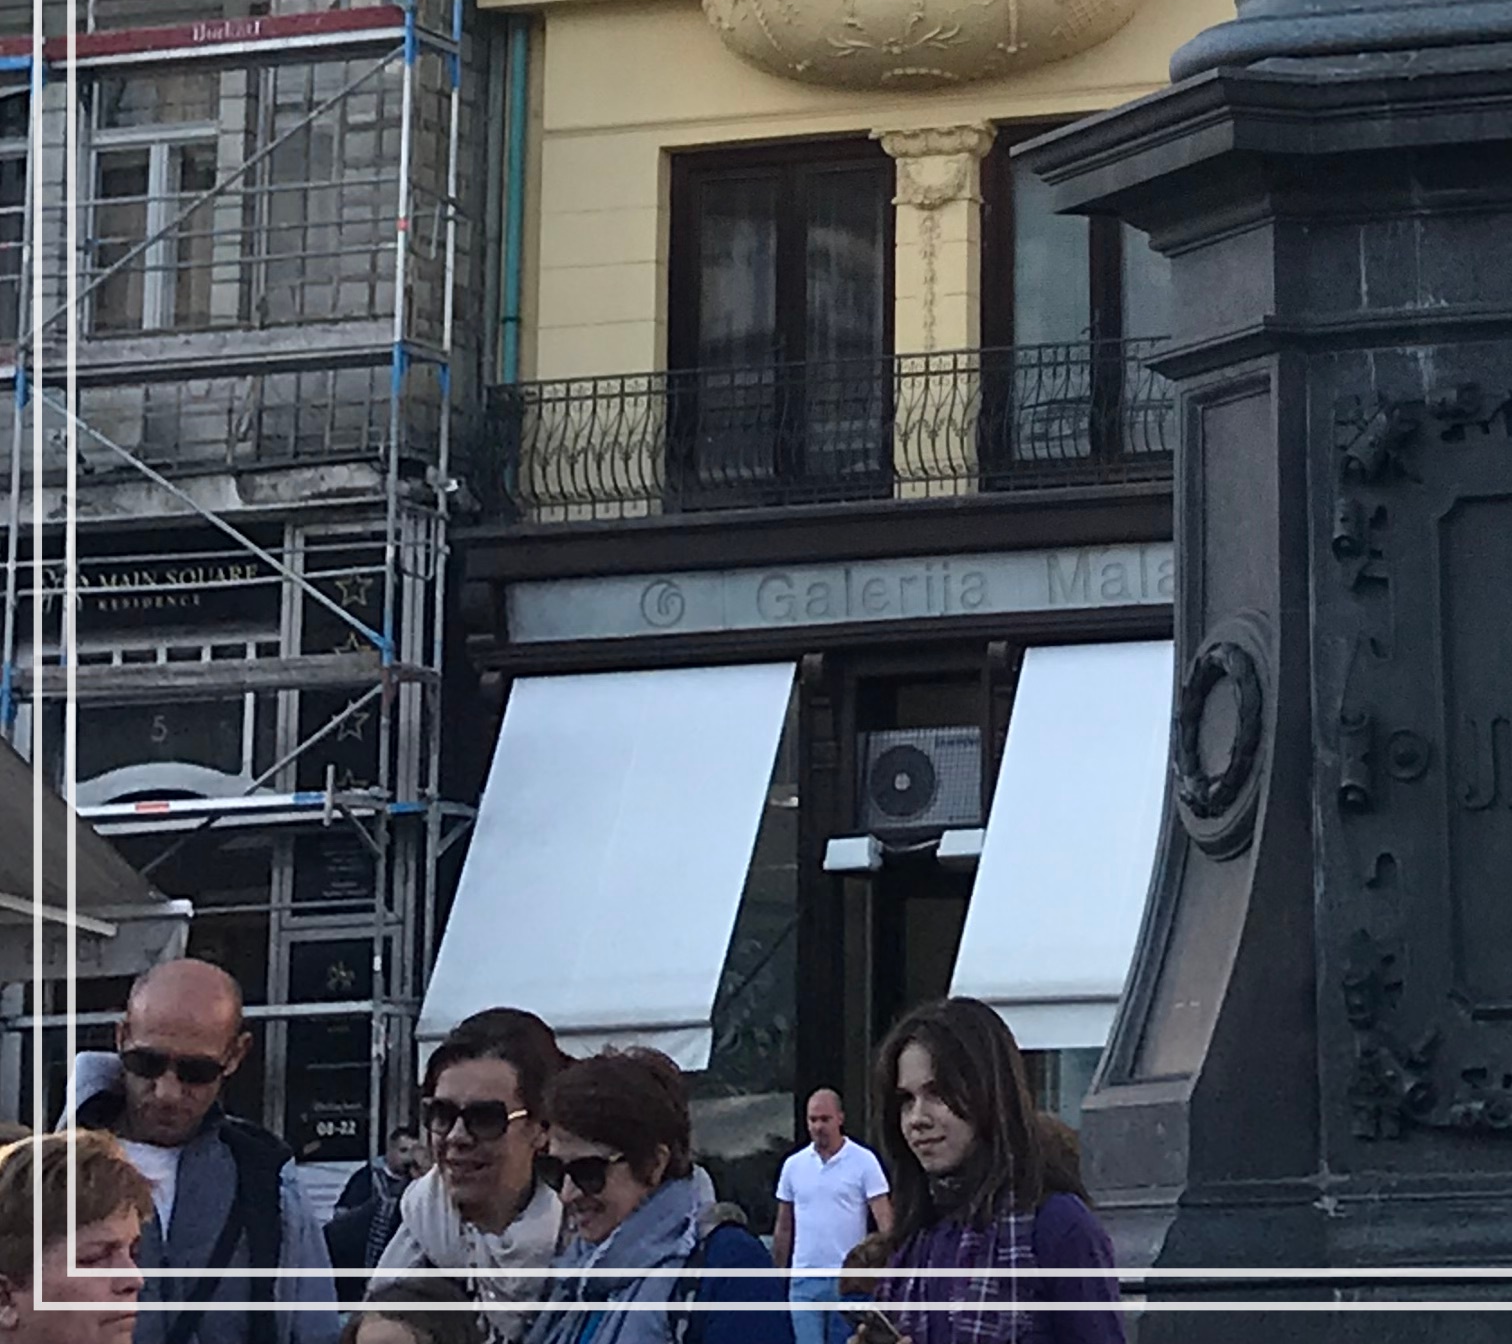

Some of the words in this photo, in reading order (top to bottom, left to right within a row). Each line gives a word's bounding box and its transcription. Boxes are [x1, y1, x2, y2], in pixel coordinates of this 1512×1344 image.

[98, 570, 157, 589] MAIN
[166, 564, 258, 586] SQUARE
[98, 593, 201, 611] RESIDENCE
[755, 562, 993, 625] Galerija
[151, 714, 168, 742] 5
